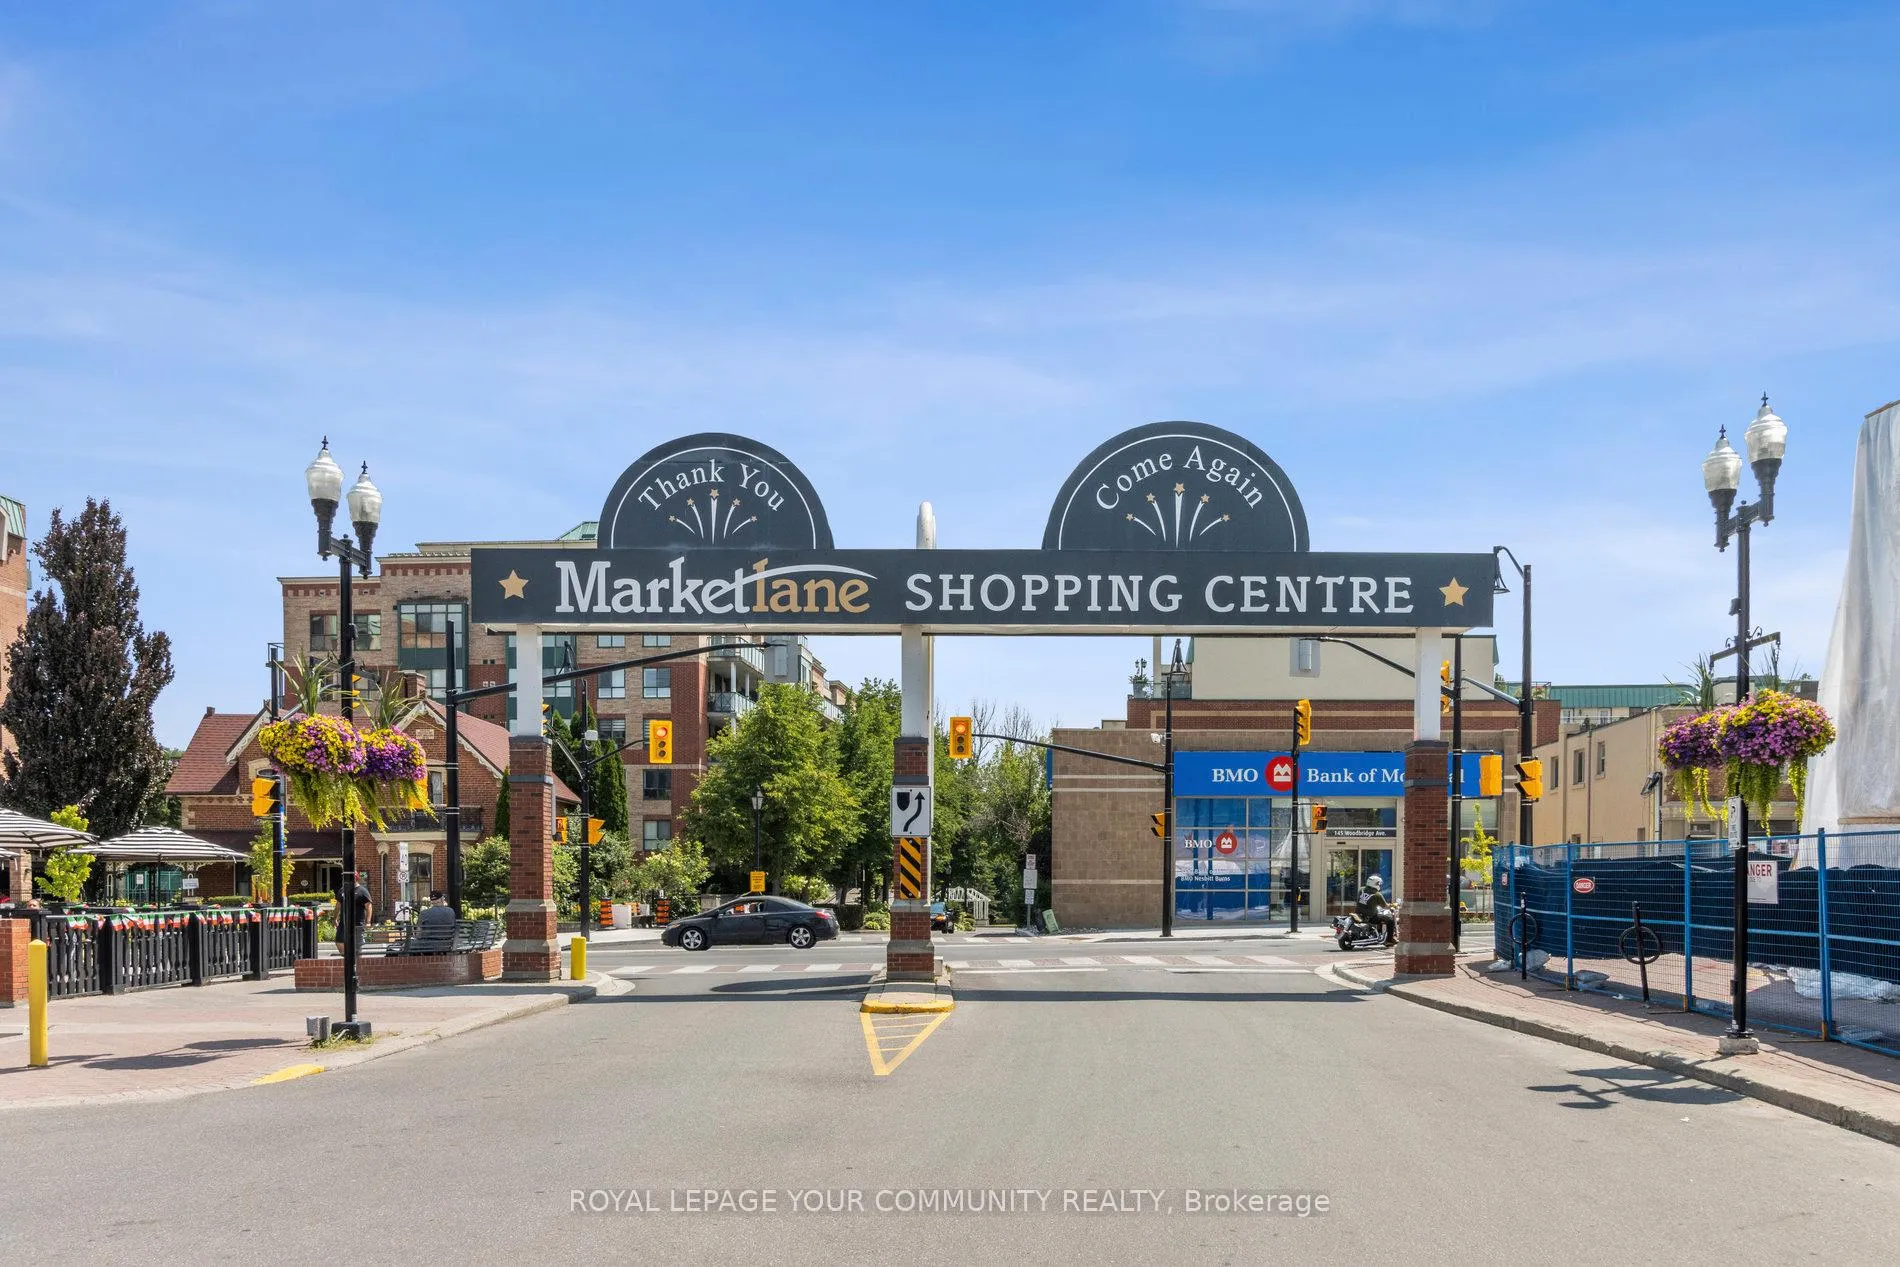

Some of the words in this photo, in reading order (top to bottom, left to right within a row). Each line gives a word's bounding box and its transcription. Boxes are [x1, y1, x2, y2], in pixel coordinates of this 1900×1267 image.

[638, 459, 725, 511] Thank
[739, 463, 785, 511] You
[1096, 453, 1173, 510] Come
[1183, 445, 1264, 509] Again
[905, 573, 1183, 613] SHOPPING
[1204, 575, 1415, 614] CENTRE
[1212, 768, 1259, 783] BMO
[1307, 768, 1355, 783] Bank
[1358, 768, 1378, 783] of
[1344, 830, 1375, 838] Woodbridge
[1184, 839, 1213, 848] BMO
[1748, 864, 1772, 877] NGER
